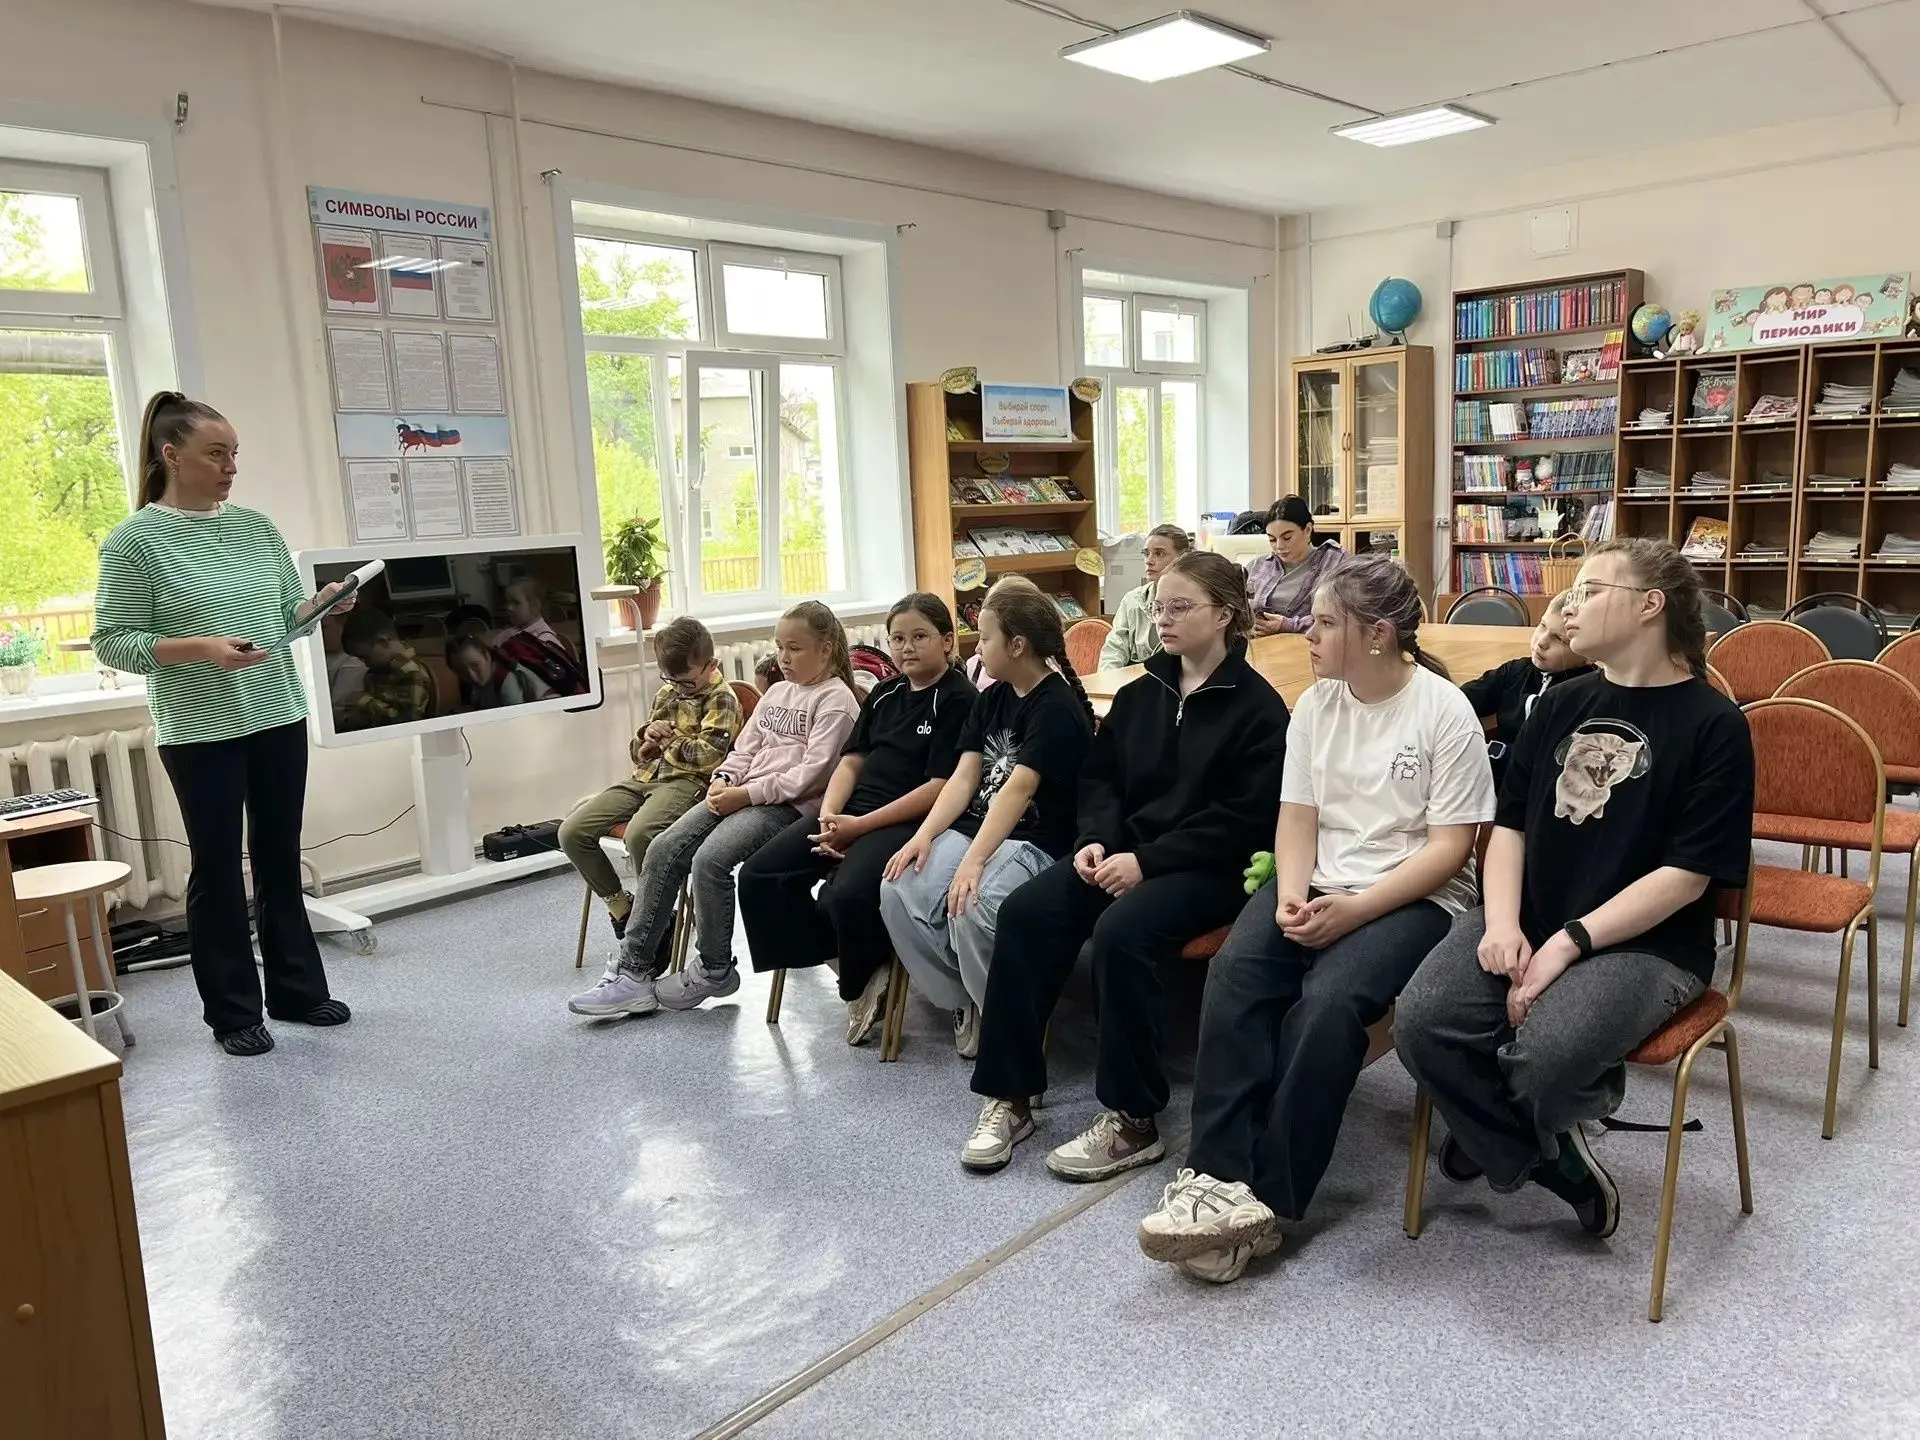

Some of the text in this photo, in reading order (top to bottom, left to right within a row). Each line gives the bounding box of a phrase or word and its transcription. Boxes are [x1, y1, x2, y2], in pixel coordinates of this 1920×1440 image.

[325, 199, 478, 229] СИМВОЛЫ РОССИИ
[1792, 309, 1828, 321] МИР
[1759, 321, 1857, 340] ПЕРИОДИКИ
[998, 401, 1029, 413] Выбирай
[992, 416, 1057, 428] Выбирай здоровье!
[760, 706, 808, 736] SHINE
[916, 720, 932, 735] alo
